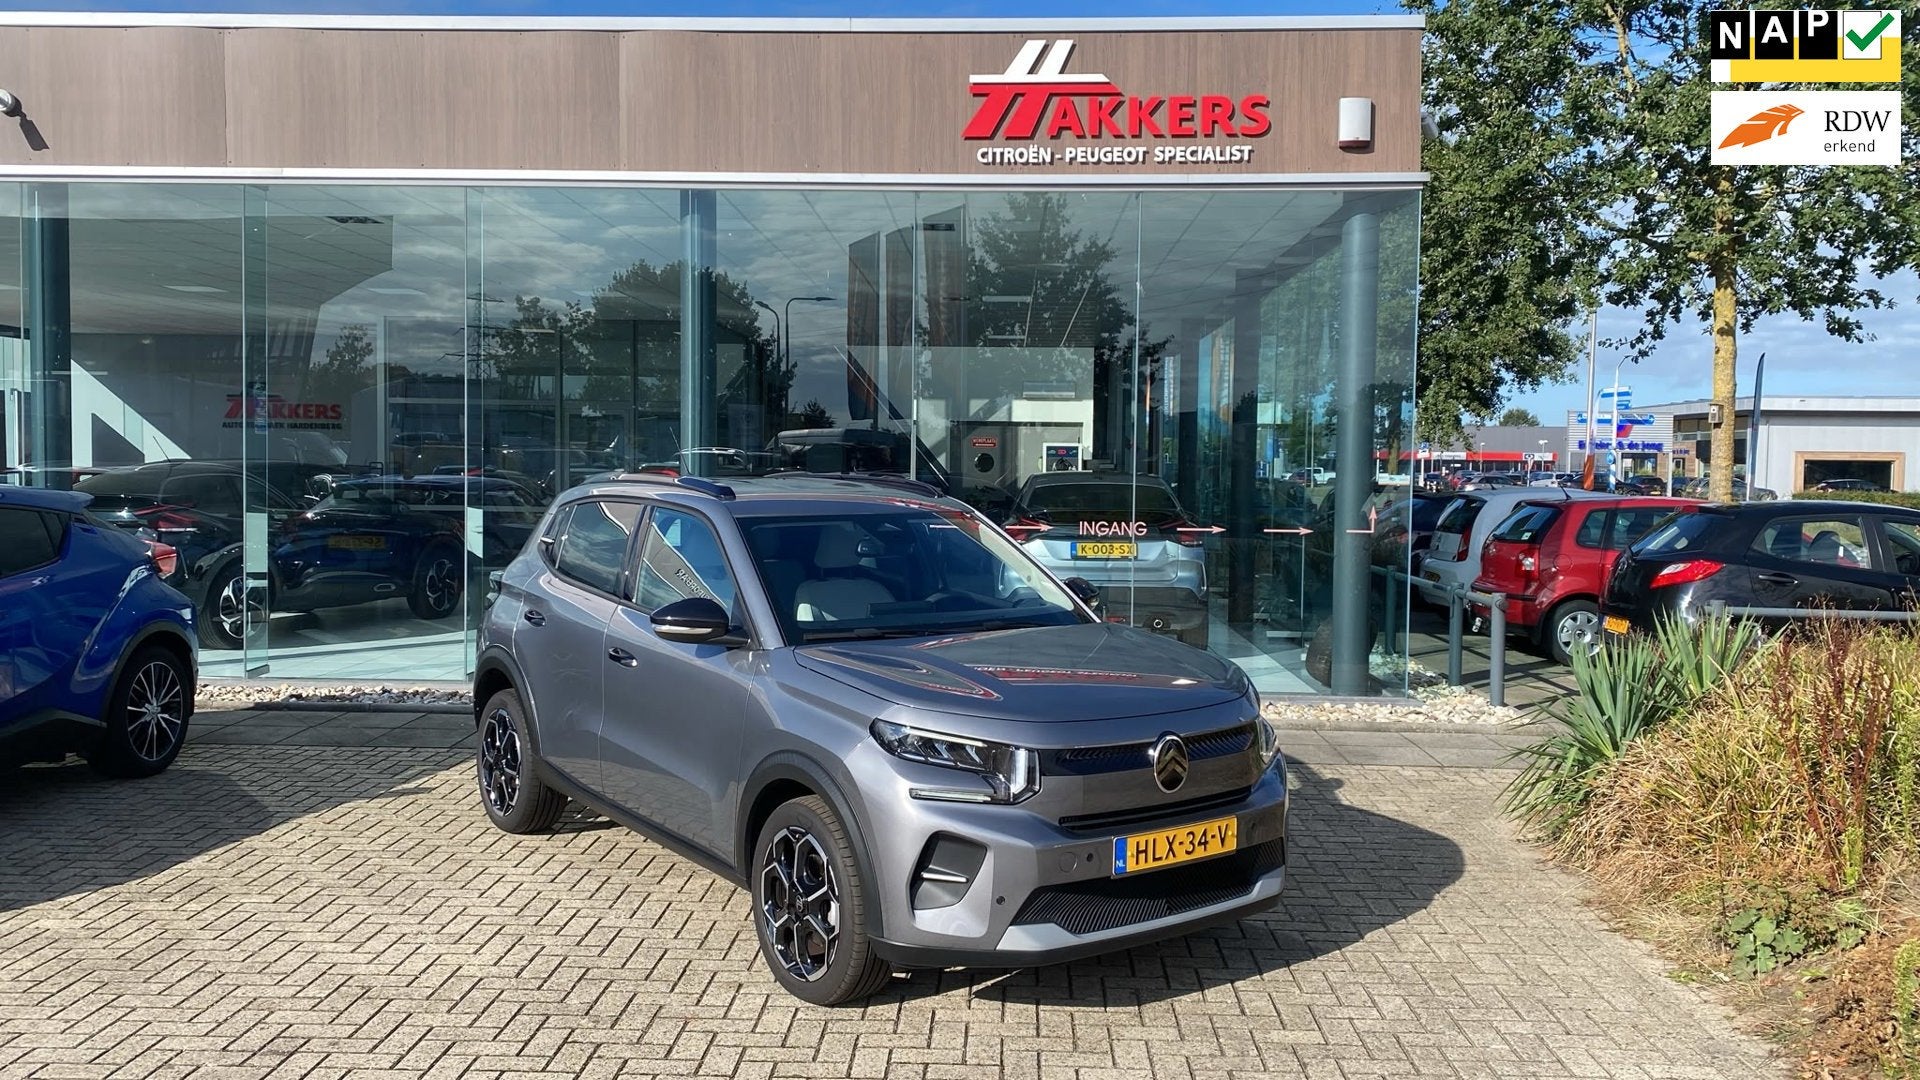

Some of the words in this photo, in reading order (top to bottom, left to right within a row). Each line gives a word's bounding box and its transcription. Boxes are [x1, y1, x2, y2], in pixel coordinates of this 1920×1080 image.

[961, 39, 1271, 138] HAKKERS
[976, 143, 1051, 164] CITROËN
[1065, 146, 1147, 162] PEUGEOT
[1153, 145, 1252, 162] SPECIALIST
[1079, 521, 1147, 537] INGANG
[1081, 545, 1134, 554] K-003-SX
[1135, 823, 1229, 865] HLX-34-V
